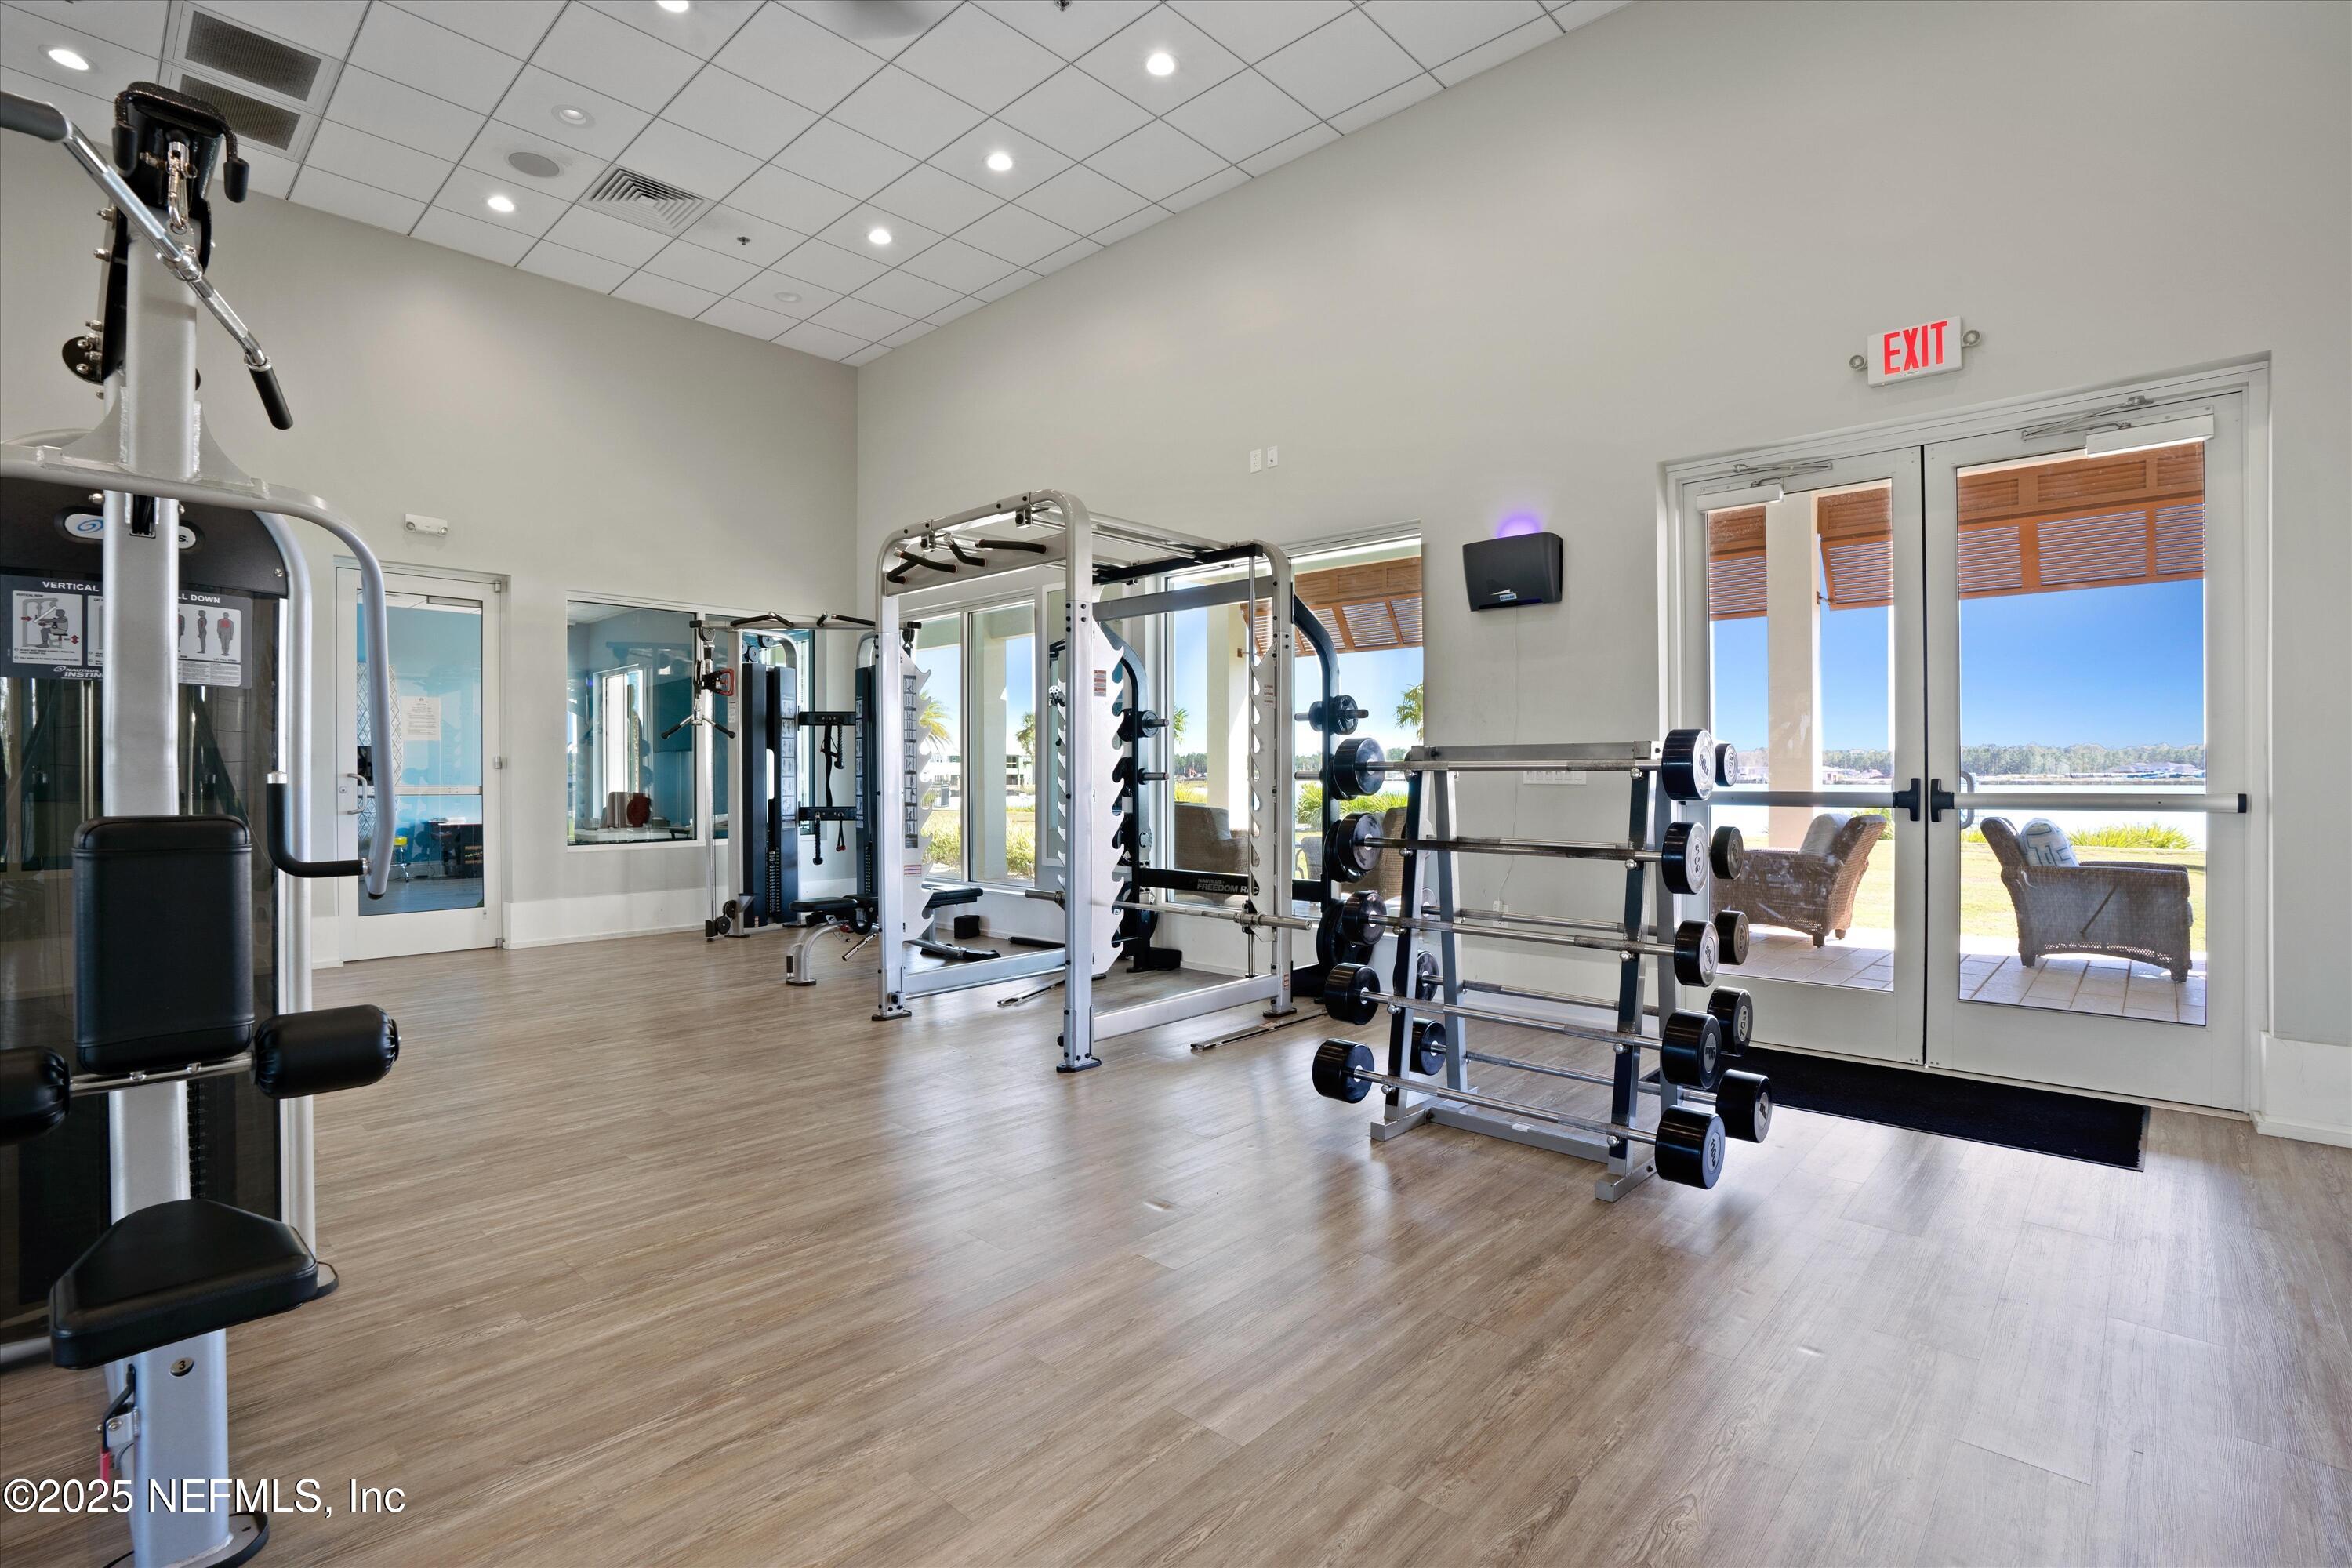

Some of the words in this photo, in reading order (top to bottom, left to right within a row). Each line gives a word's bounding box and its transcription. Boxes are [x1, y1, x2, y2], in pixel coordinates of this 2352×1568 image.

[1884, 321, 1947, 376] EXIT
[42, 581, 100, 592] VERTICAL
[191, 594, 220, 604] DOWN
[1197, 884, 1239, 893] FREEDOM
[178, 1360, 186, 1370] 3
